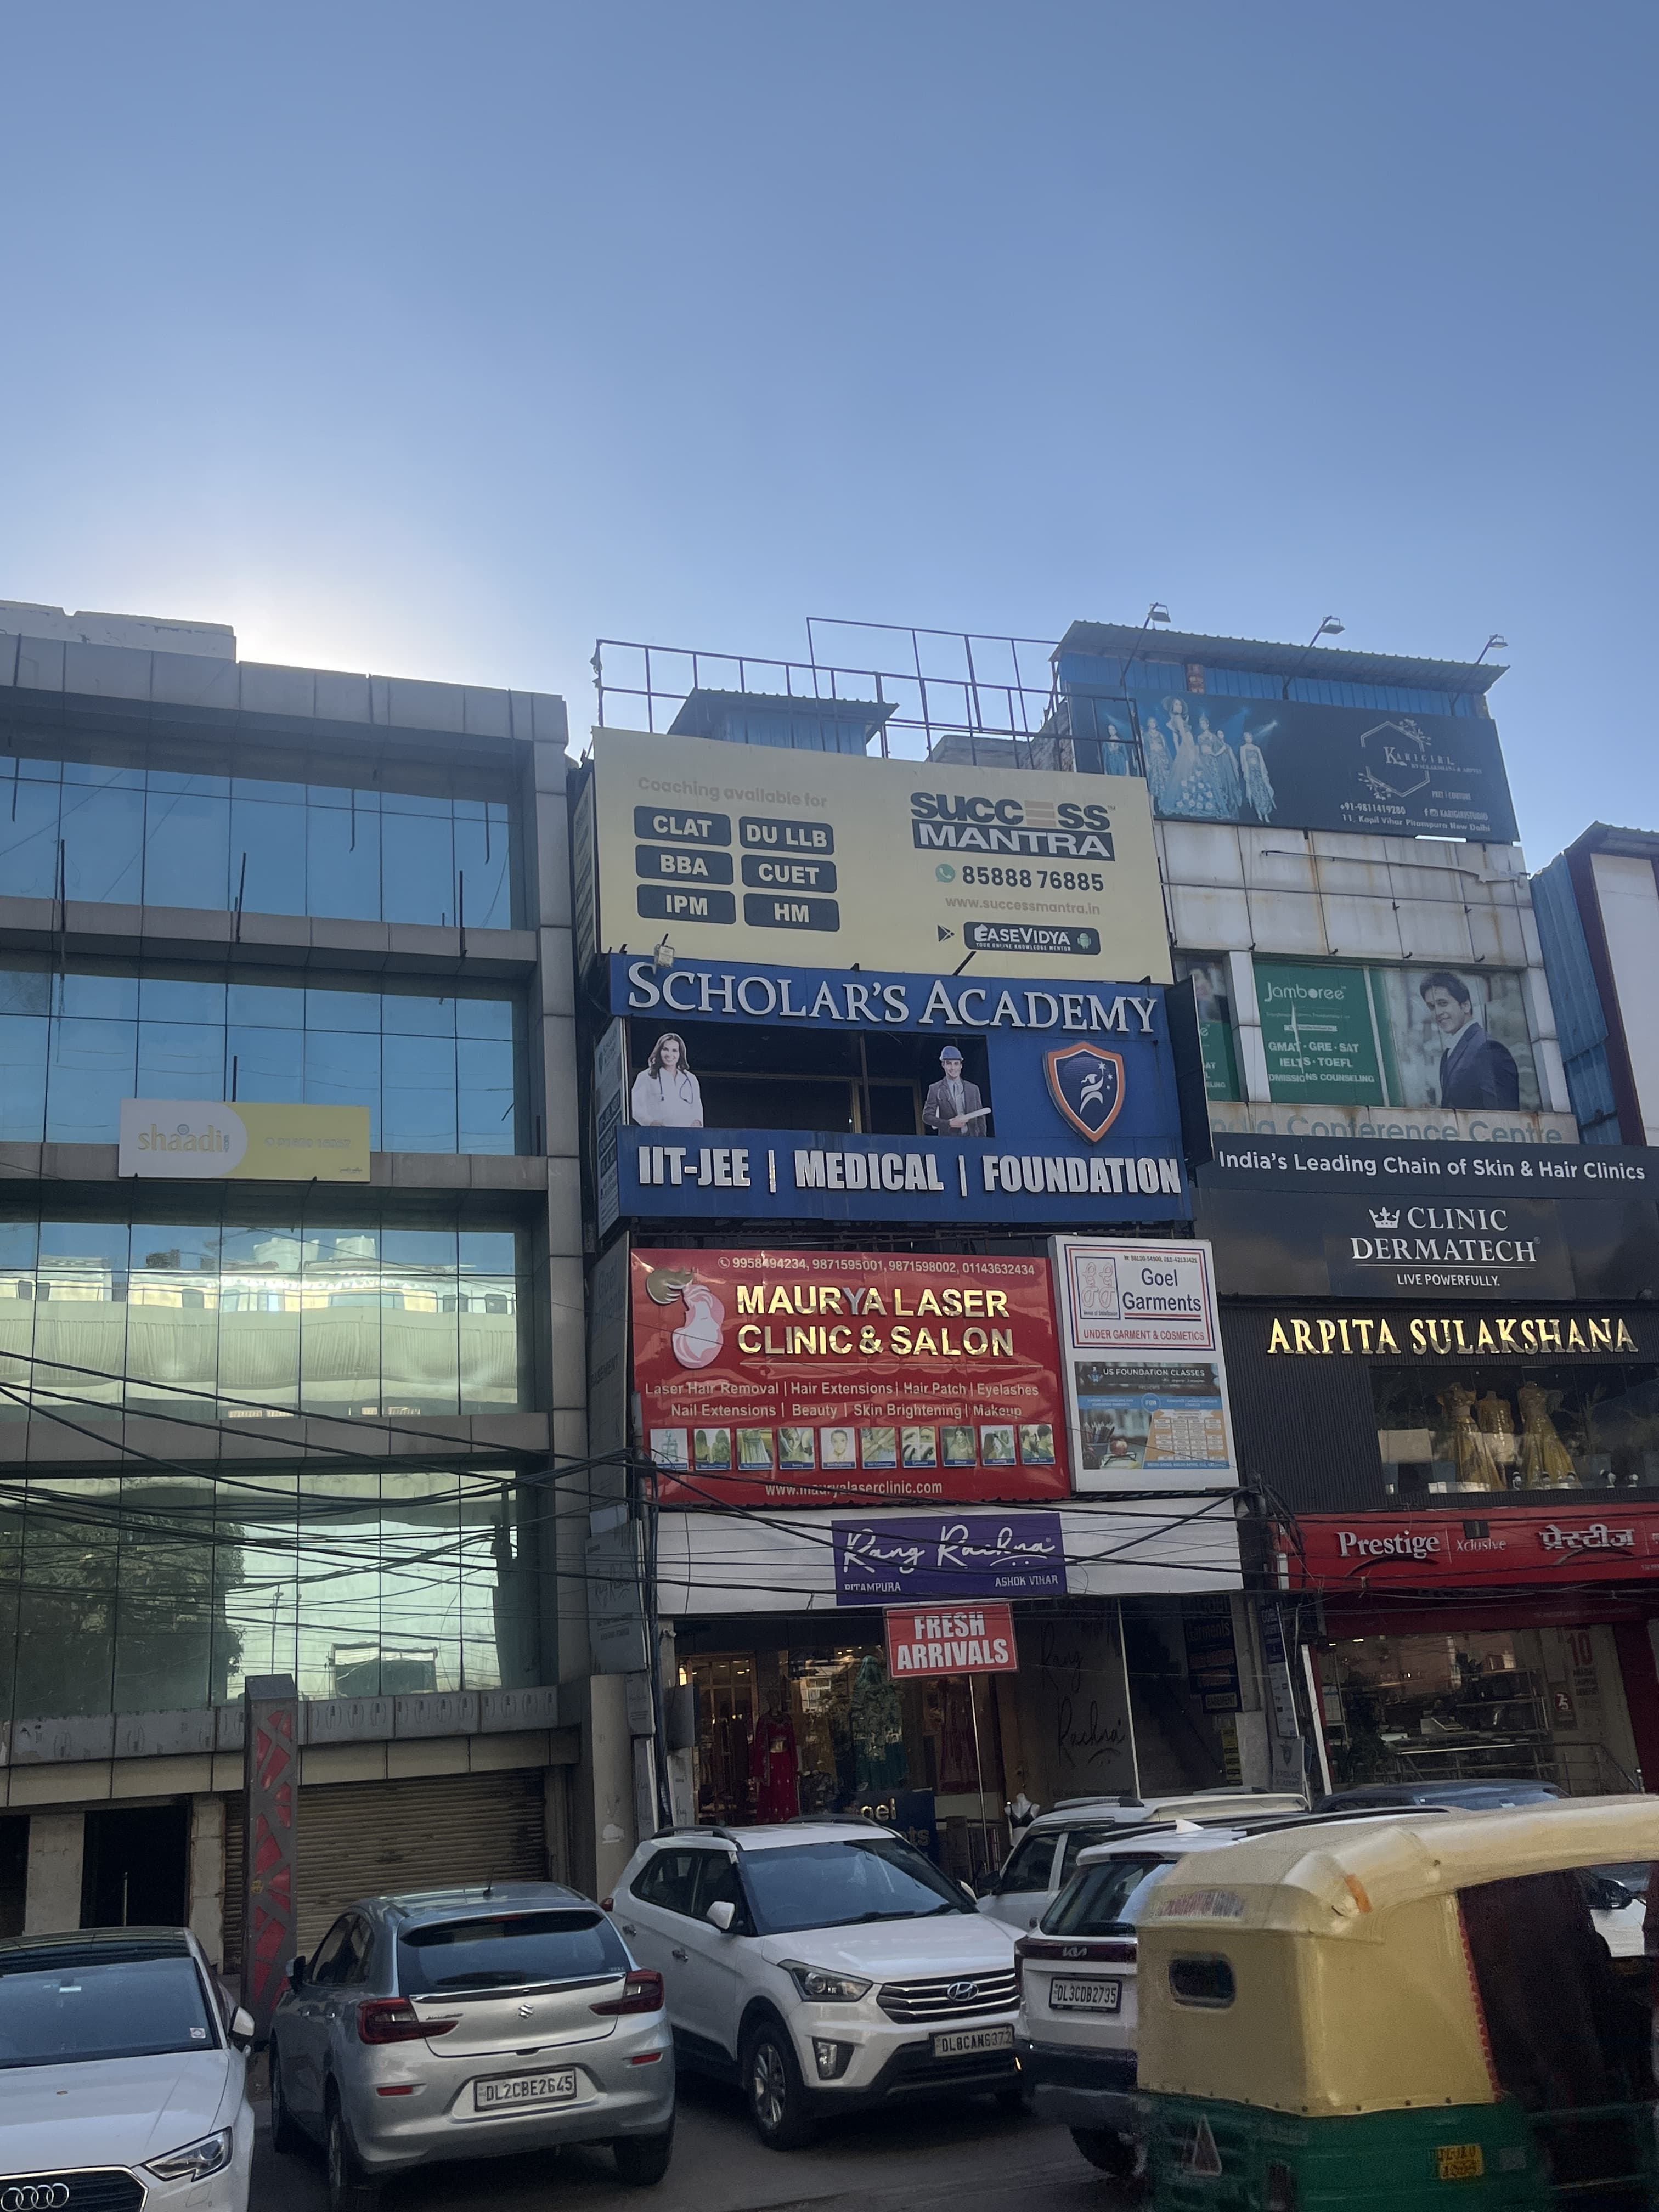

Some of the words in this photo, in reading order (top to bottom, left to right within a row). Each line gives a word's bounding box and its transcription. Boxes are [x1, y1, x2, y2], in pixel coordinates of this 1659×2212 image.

[639, 777, 719, 802] Coaching
[724, 787, 800, 806] available
[804, 793, 827, 808] for
[653, 815, 712, 838] CLAT
[1358, 816, 1379, 825] Kapil
[1382, 817, 1403, 826] Vihar
[1406, 819, 1448, 830] Pitampura
[1470, 822, 1491, 831] Delhi
[746, 824, 778, 843] DU
[785, 827, 827, 848] LLB
[919, 823, 1111, 857] MANTRA
[660, 854, 709, 876] BBA
[758, 864, 820, 885] CUET
[962, 865, 1032, 888] 85888
[1037, 871, 1104, 892] 76885
[666, 894, 708, 916] IPM
[774, 902, 810, 923] HM
[945, 897, 1101, 915] www.successmantra.in
[1264, 981, 1345, 1002] Jamboree
[919, 979, 1157, 1032] ACADEMY
[1308, 1042, 1333, 1052] GRE
[1339, 1043, 1359, 1053] SAT
[1317, 1057, 1353, 1068] TOEFL
[1320, 1074, 1375, 1083] COUNSELING
[639, 1146, 751, 1186] IIT-JEE
[794, 1150, 944, 1190] MEDICAL
[981, 1155, 1182, 1194] FOUNDATION
[1218, 1150, 1288, 1171] India's
[1294, 1153, 1377, 1176] Leading
[1383, 1157, 1441, 1175] Chain
[1447, 1158, 1466, 1176] of
[1473, 1159, 1515, 1177] Skin
[1520, 1161, 1533, 1177] &
[1539, 1160, 1577, 1179] Hair
[1583, 1161, 1646, 1181] Clinics
[1407, 1206, 1508, 1231] CLINIC
[1351, 1237, 1537, 1263] DERMATECH
[962, 1263, 1035, 1276] 01143632434
[1141, 1267, 1178, 1287] Goel
[1397, 1273, 1422, 1286] LIVE
[1425, 1273, 1500, 1288] POWERFULLY.
[736, 1284, 888, 1316] MAURYA
[894, 1288, 1010, 1318] LASER
[1122, 1291, 1201, 1311] Garments
[737, 1324, 853, 1355] CLINIC
[859, 1325, 884, 1355] &
[891, 1325, 1014, 1356] SALON
[1083, 1329, 1111, 1339] UNDER
[1113, 1330, 1150, 1340] GARMENT
[1153, 1331, 1159, 1340] &
[1160, 1331, 1205, 1341] COSMETICS
[1267, 1318, 1402, 1356] ARPITA
[1409, 1318, 1639, 1356] SULAKSHANA
[646, 1383, 683, 1395] Laser
[688, 1383, 715, 1395] Hair
[721, 1383, 779, 1395] Removal
[791, 1383, 817, 1395] Hair
[821, 1383, 893, 1395] Extensions
[904, 1383, 929, 1395] Hair
[932, 1383, 966, 1395] Patch
[977, 1383, 1039, 1398] Eyelashes
[671, 1404, 697, 1417] Nail
[701, 1404, 776, 1417] Extensions
[792, 1404, 838, 1419] Beauty
[854, 1404, 882, 1417] Skin
[887, 1403, 962, 1419] Brightening
[973, 1404, 1022, 1420] Makeup
[1338, 1529, 1441, 1559] Prestige
[1539, 1523, 1635, 1550] प्रेस्टीज
[843, 1527, 926, 1575] Rang
[995, 1576, 1026, 1587] ASHOK
[1029, 1574, 1059, 1585] VIHAR
[914, 1611, 985, 1640] FRESH
[898, 1638, 1009, 1671] ARRIVALS
[861, 1797, 896, 1821] oel
[1057, 1984, 1117, 2004] DL3CDB2735
[486, 2076, 572, 2102] DL2CBE2645
